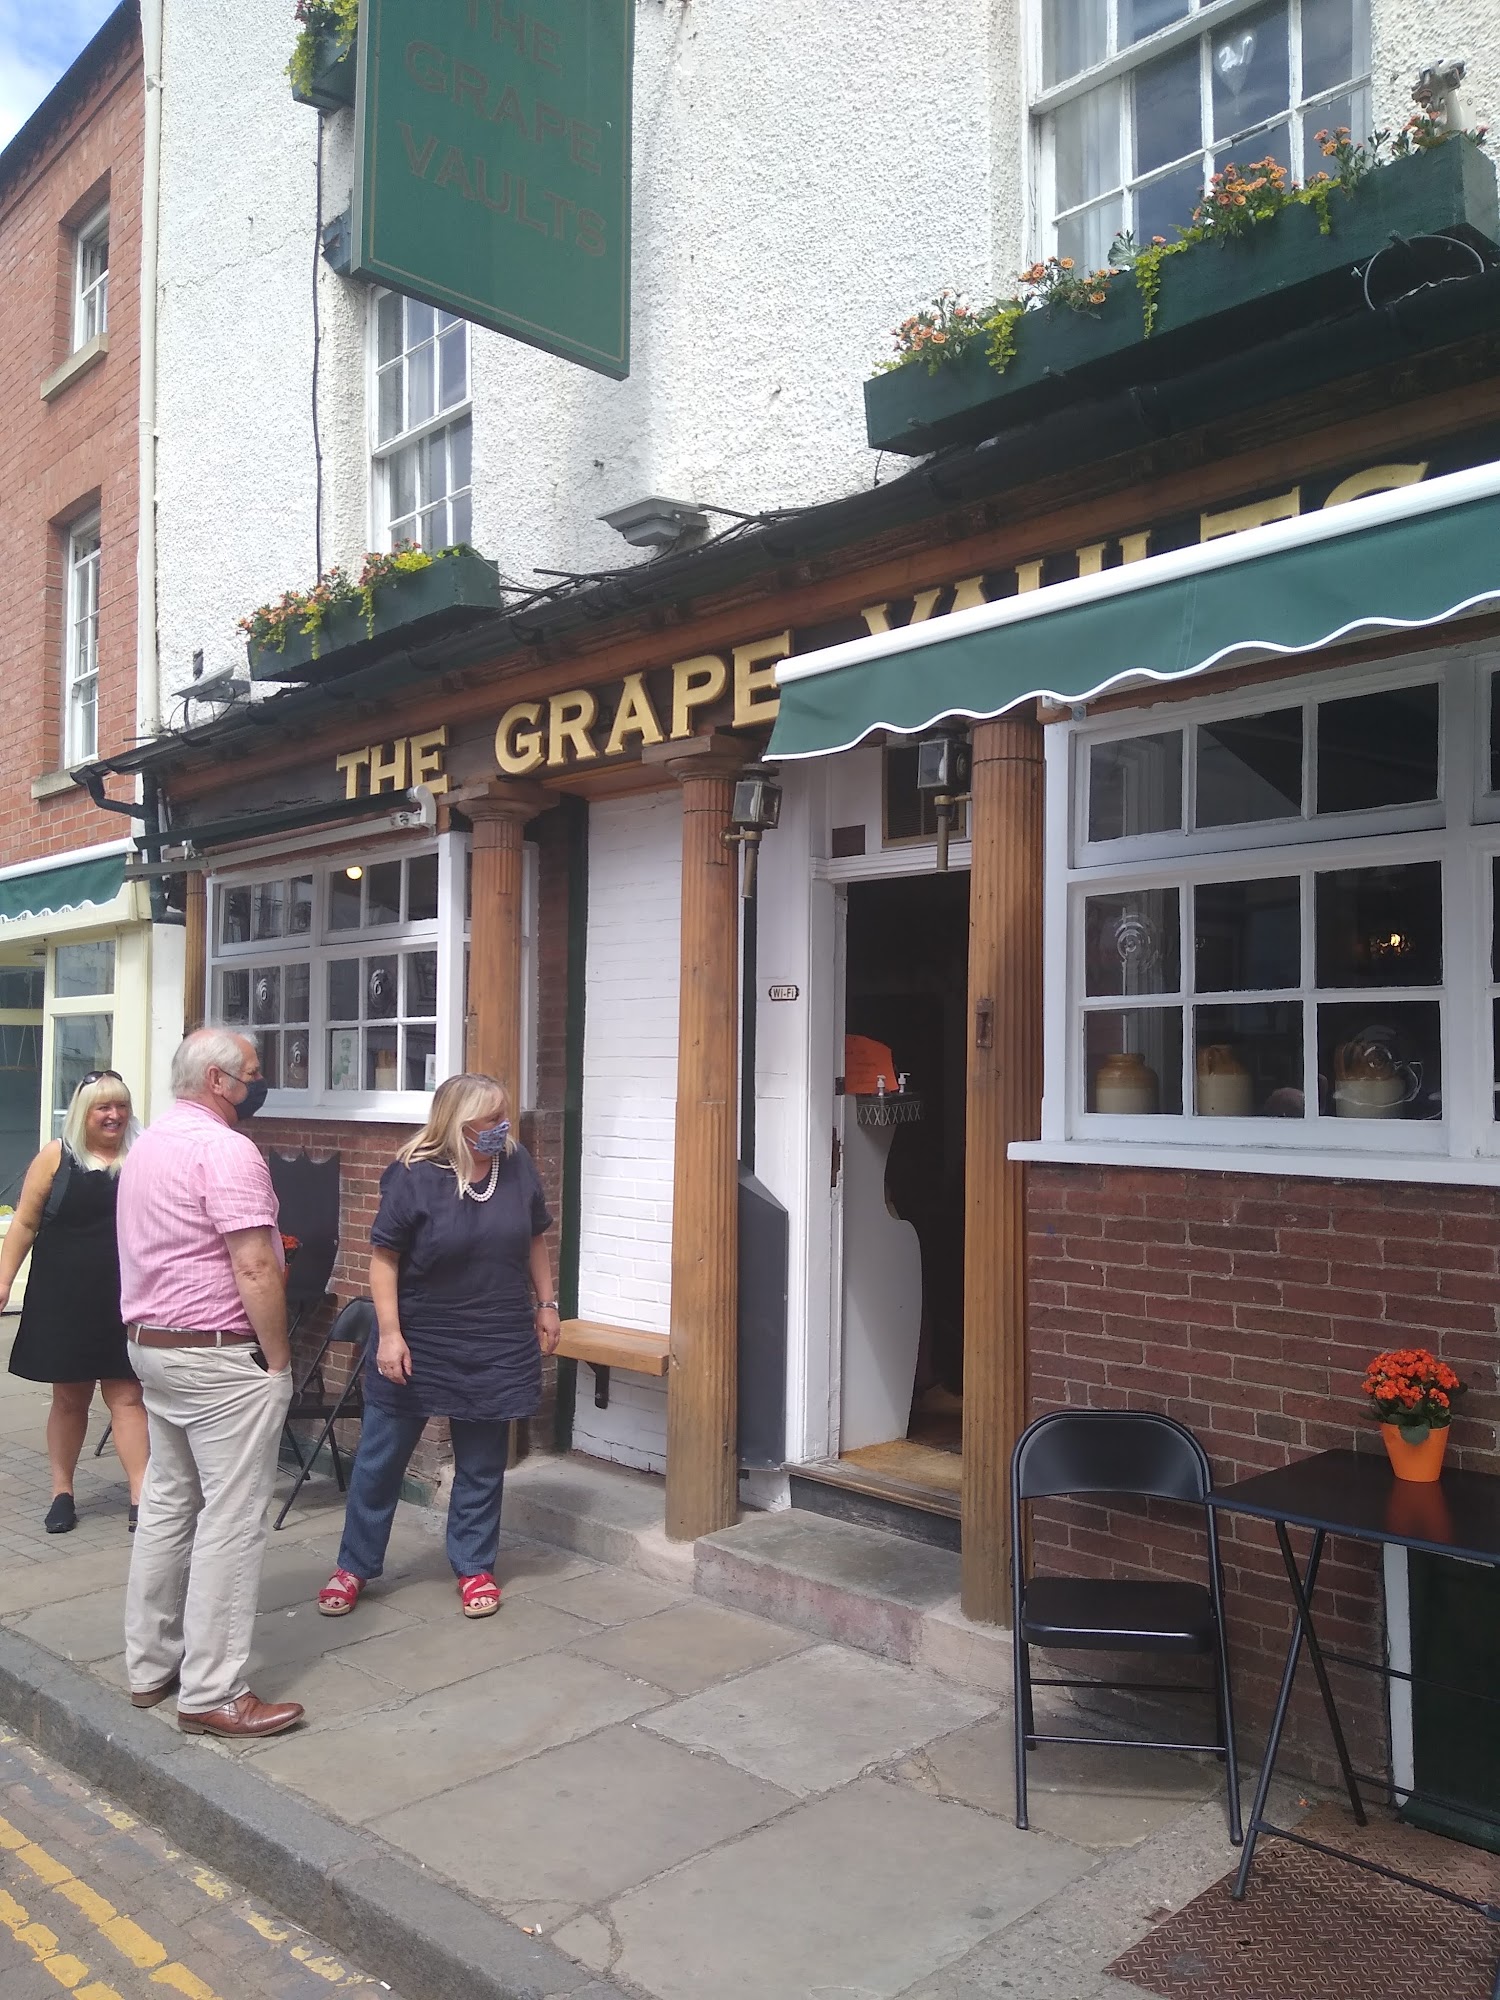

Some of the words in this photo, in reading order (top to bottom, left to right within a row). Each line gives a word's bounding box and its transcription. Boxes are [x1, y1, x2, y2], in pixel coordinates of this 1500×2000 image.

[404, 40, 602, 176] GRAPE
[396, 119, 607, 257] VAULTS
[336, 724, 448, 800] THE
[494, 629, 792, 775] GRAPE
[773, 988, 794, 998] Wi-Fi
